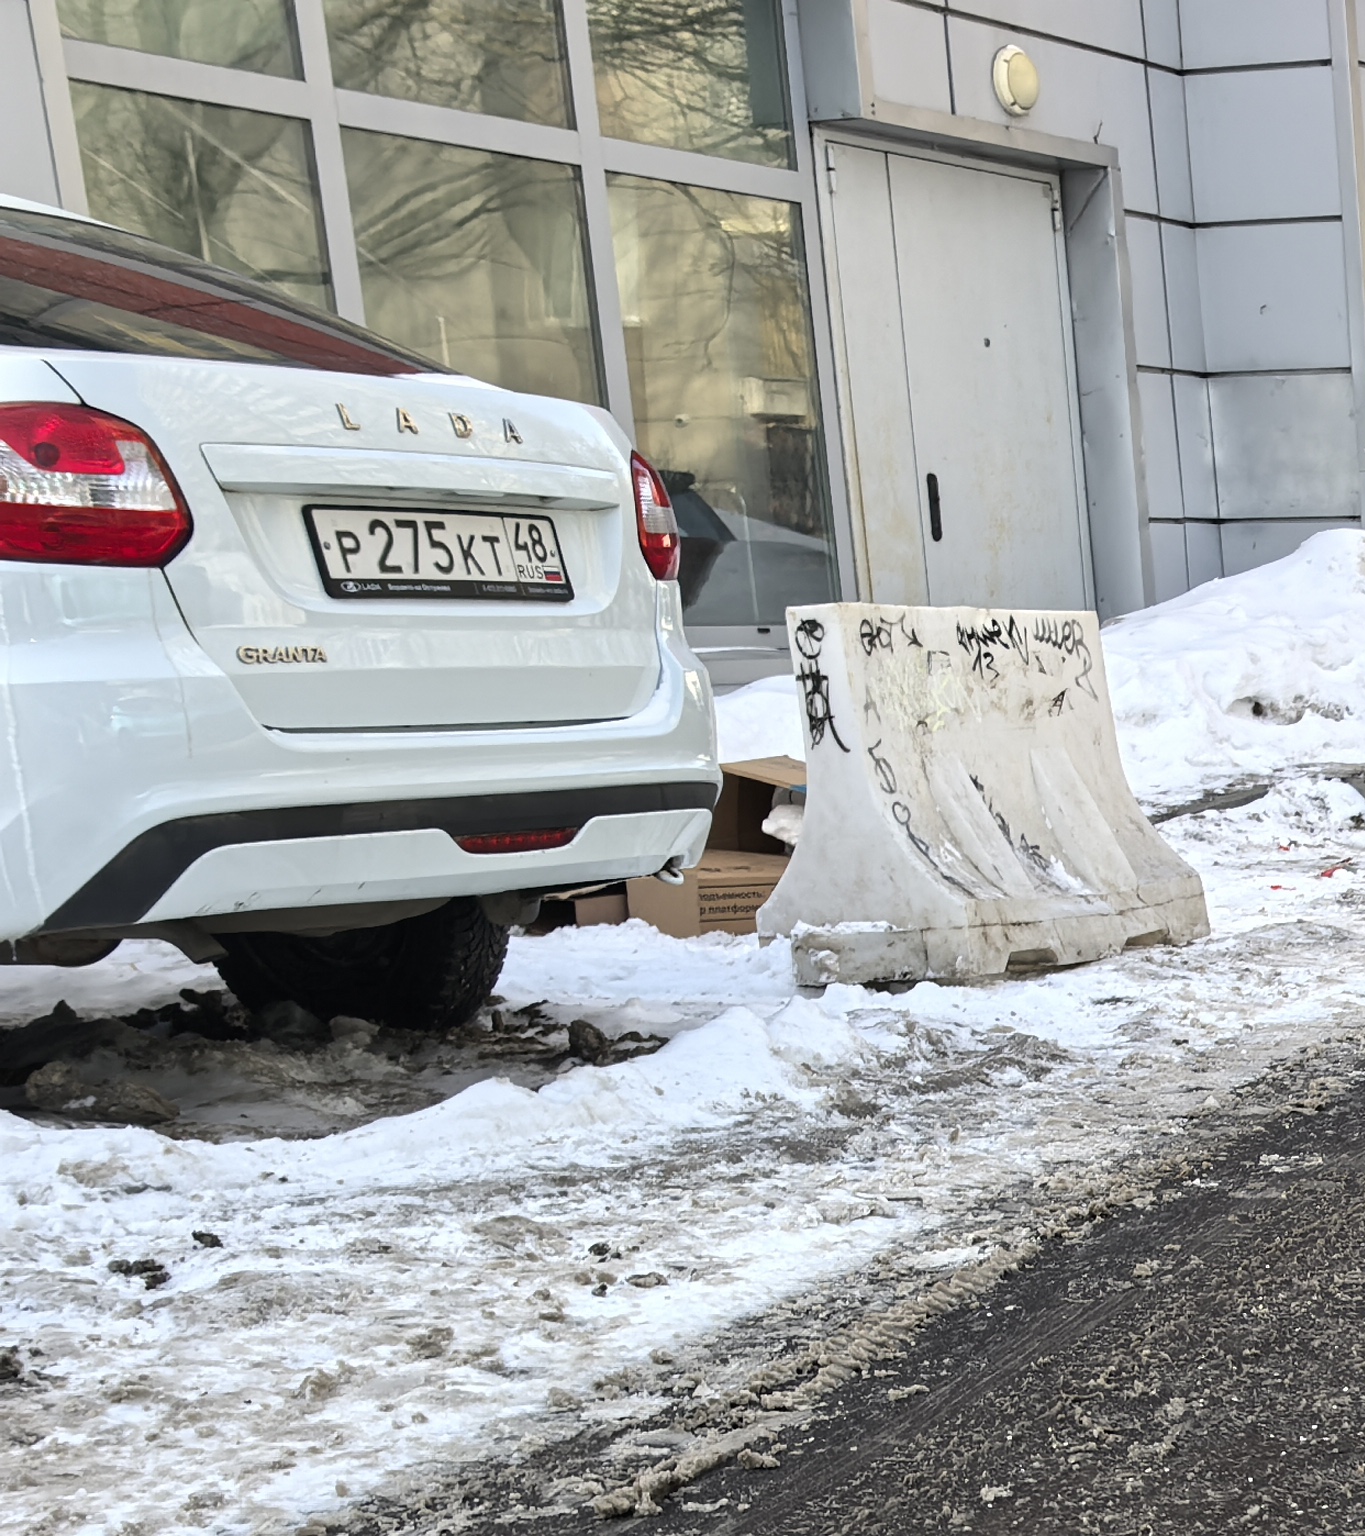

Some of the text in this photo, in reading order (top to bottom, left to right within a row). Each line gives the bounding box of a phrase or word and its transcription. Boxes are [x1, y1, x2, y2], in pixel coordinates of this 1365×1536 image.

[335, 402, 523, 444] LADA
[334, 518, 548, 577] Р275КТ 48
[517, 564, 544, 580] RUS
[237, 644, 328, 665] GRANTA
